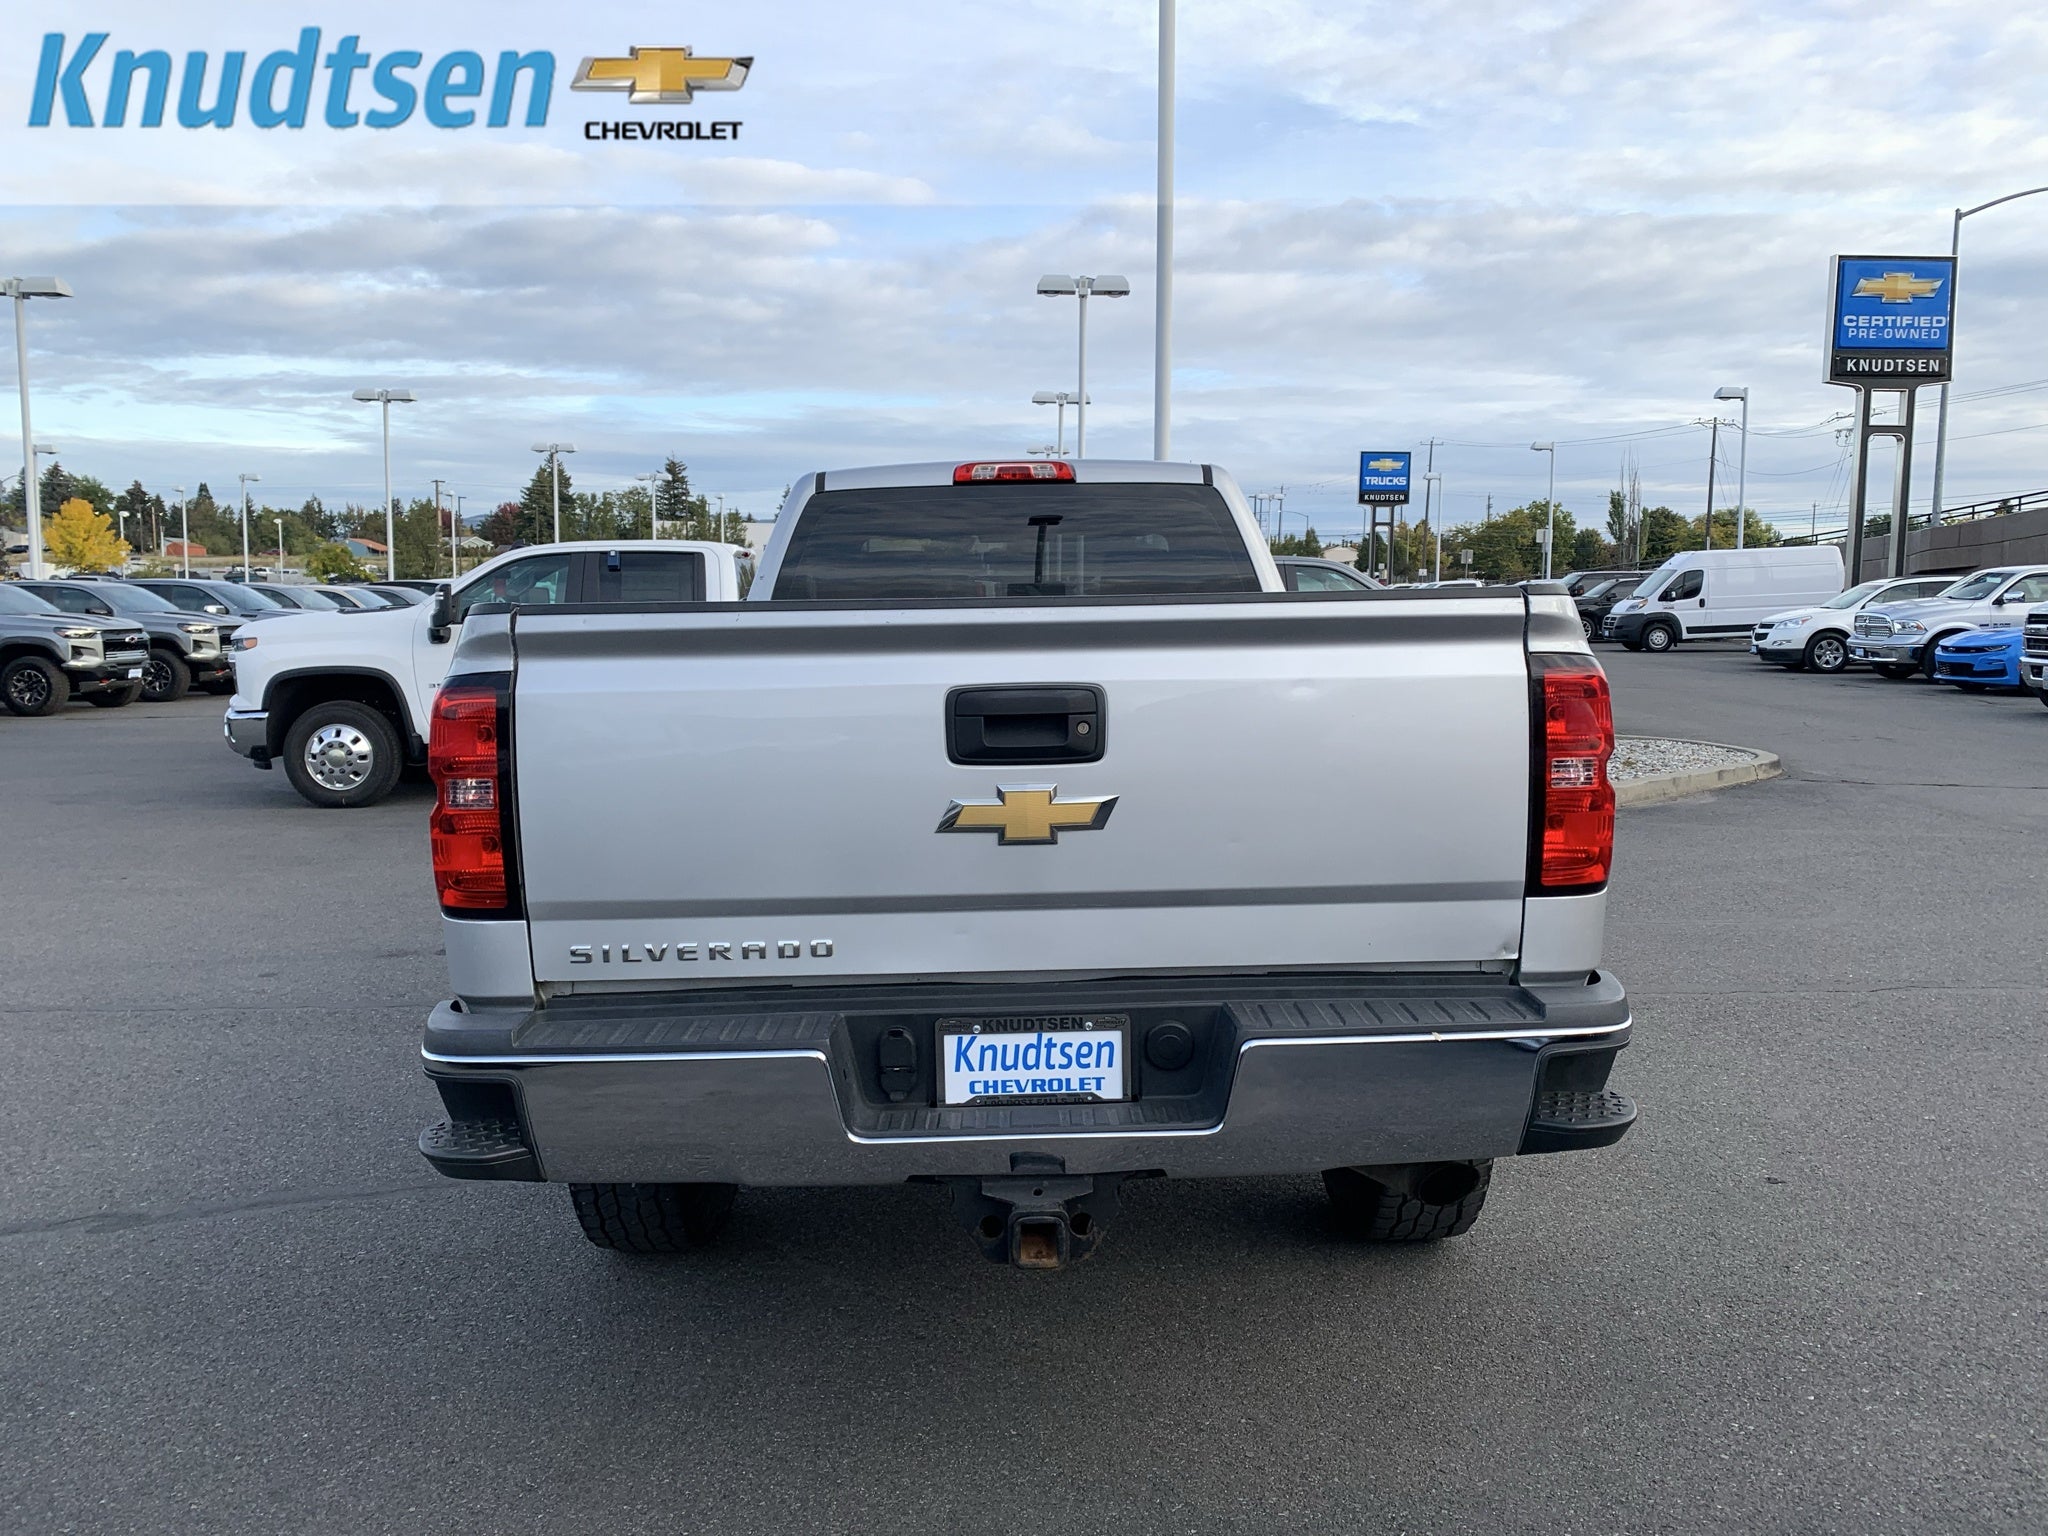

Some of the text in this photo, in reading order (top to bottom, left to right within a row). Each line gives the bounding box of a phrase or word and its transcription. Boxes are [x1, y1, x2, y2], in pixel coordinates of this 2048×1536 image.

[1843, 315, 1947, 328] CERTIFIED
[1848, 328, 1940, 339] PRE-OWNED
[1846, 358, 1940, 373] KNUDTSEN
[1364, 476, 1407, 486] TRUCKS
[569, 938, 834, 964] SILVERADO
[980, 1016, 1084, 1032] KNUDTSEN
[954, 1032, 1115, 1073] Knudtsen
[969, 1077, 1105, 1094] CHEVROLET
